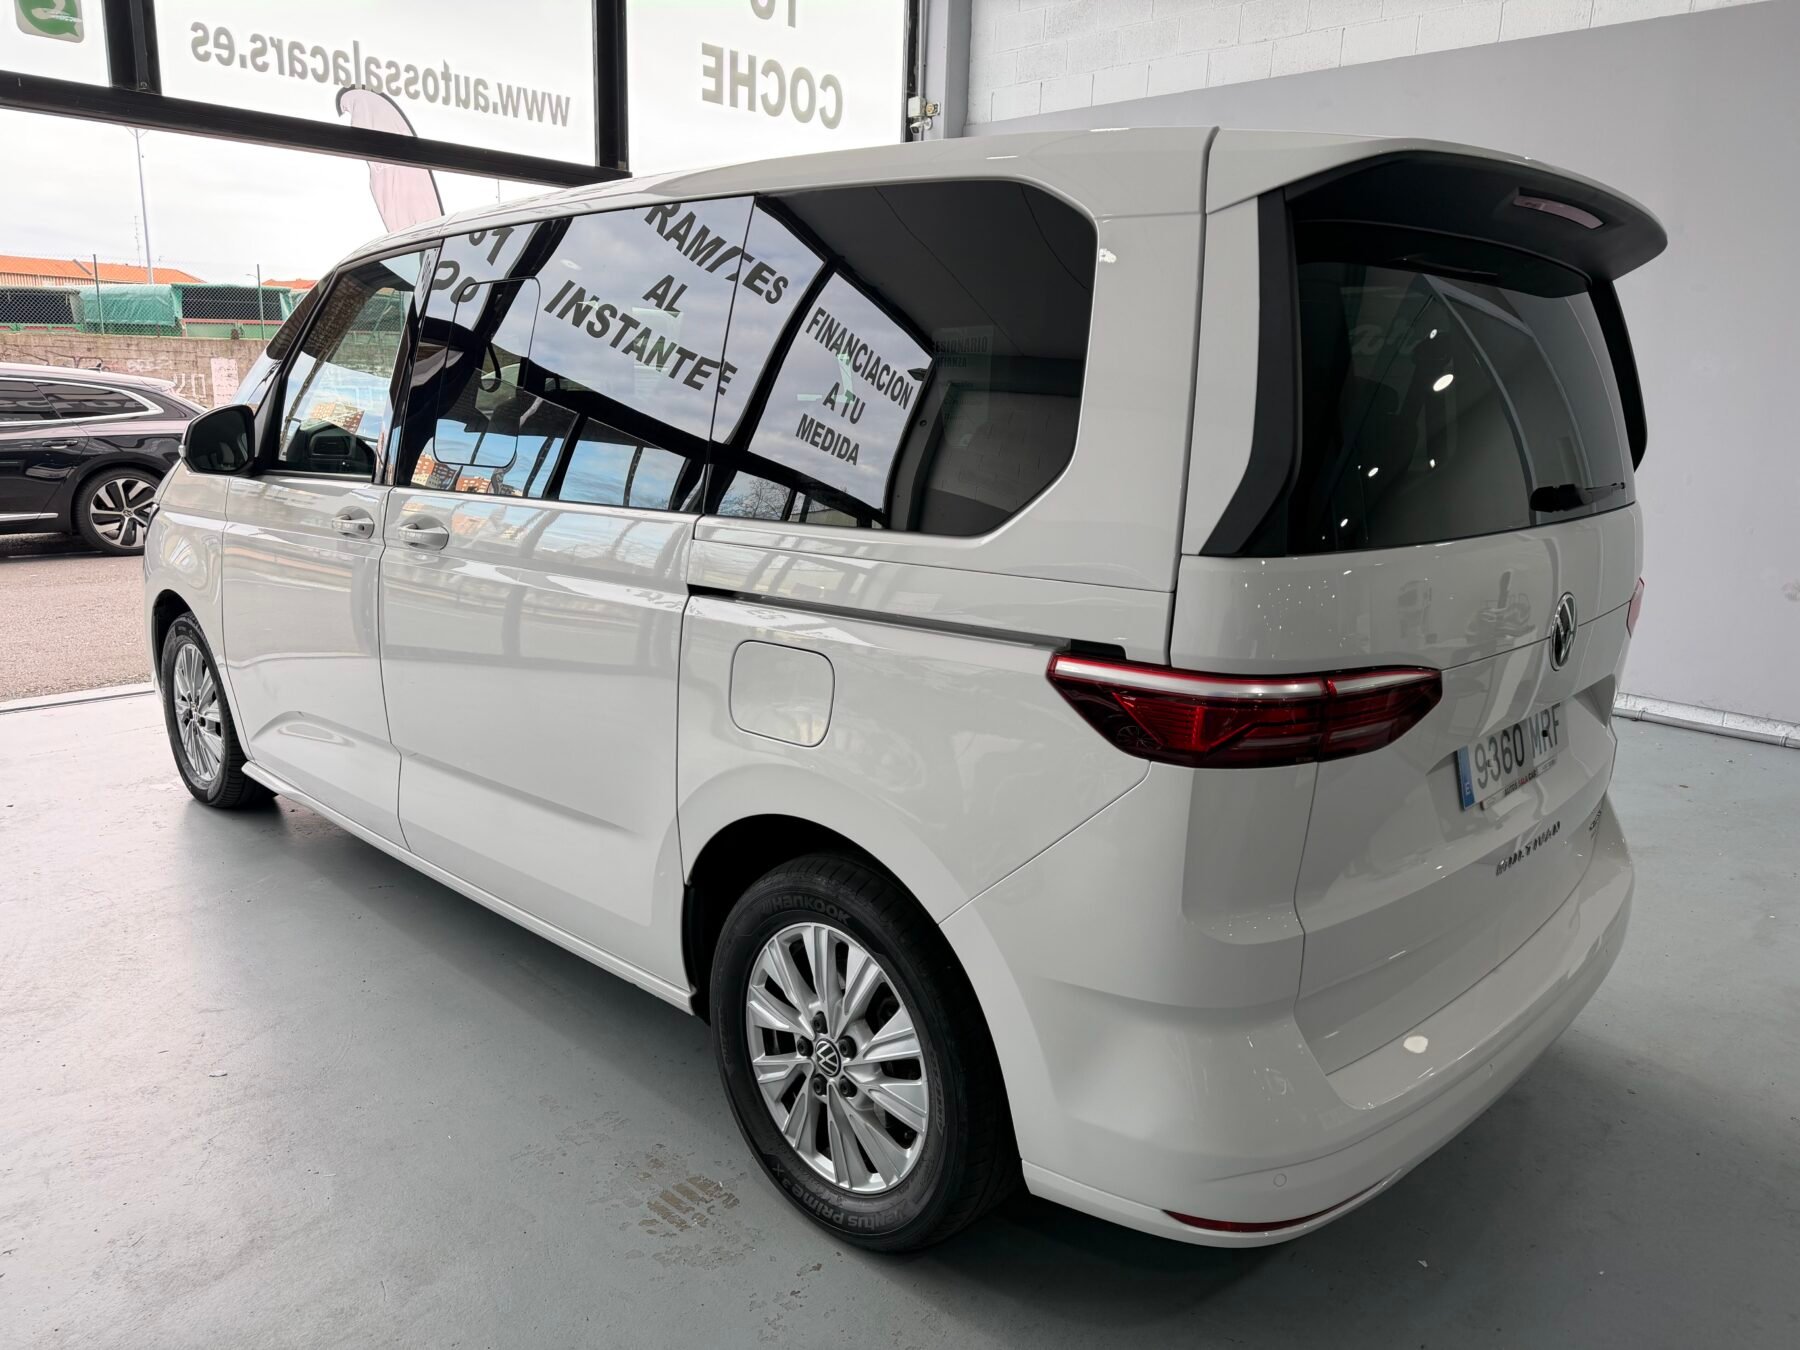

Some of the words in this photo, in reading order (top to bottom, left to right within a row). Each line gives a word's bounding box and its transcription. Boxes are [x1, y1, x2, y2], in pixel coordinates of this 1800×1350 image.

[642, 275, 688, 318] AL
[805, 306, 914, 410] FINANCIACION
[822, 381, 841, 411] A
[840, 389, 866, 424] TU
[795, 413, 860, 466] MEDIDA
[1474, 723, 1525, 790] 9360
[1528, 702, 1561, 759] MRF
[1463, 781, 1472, 795] E
